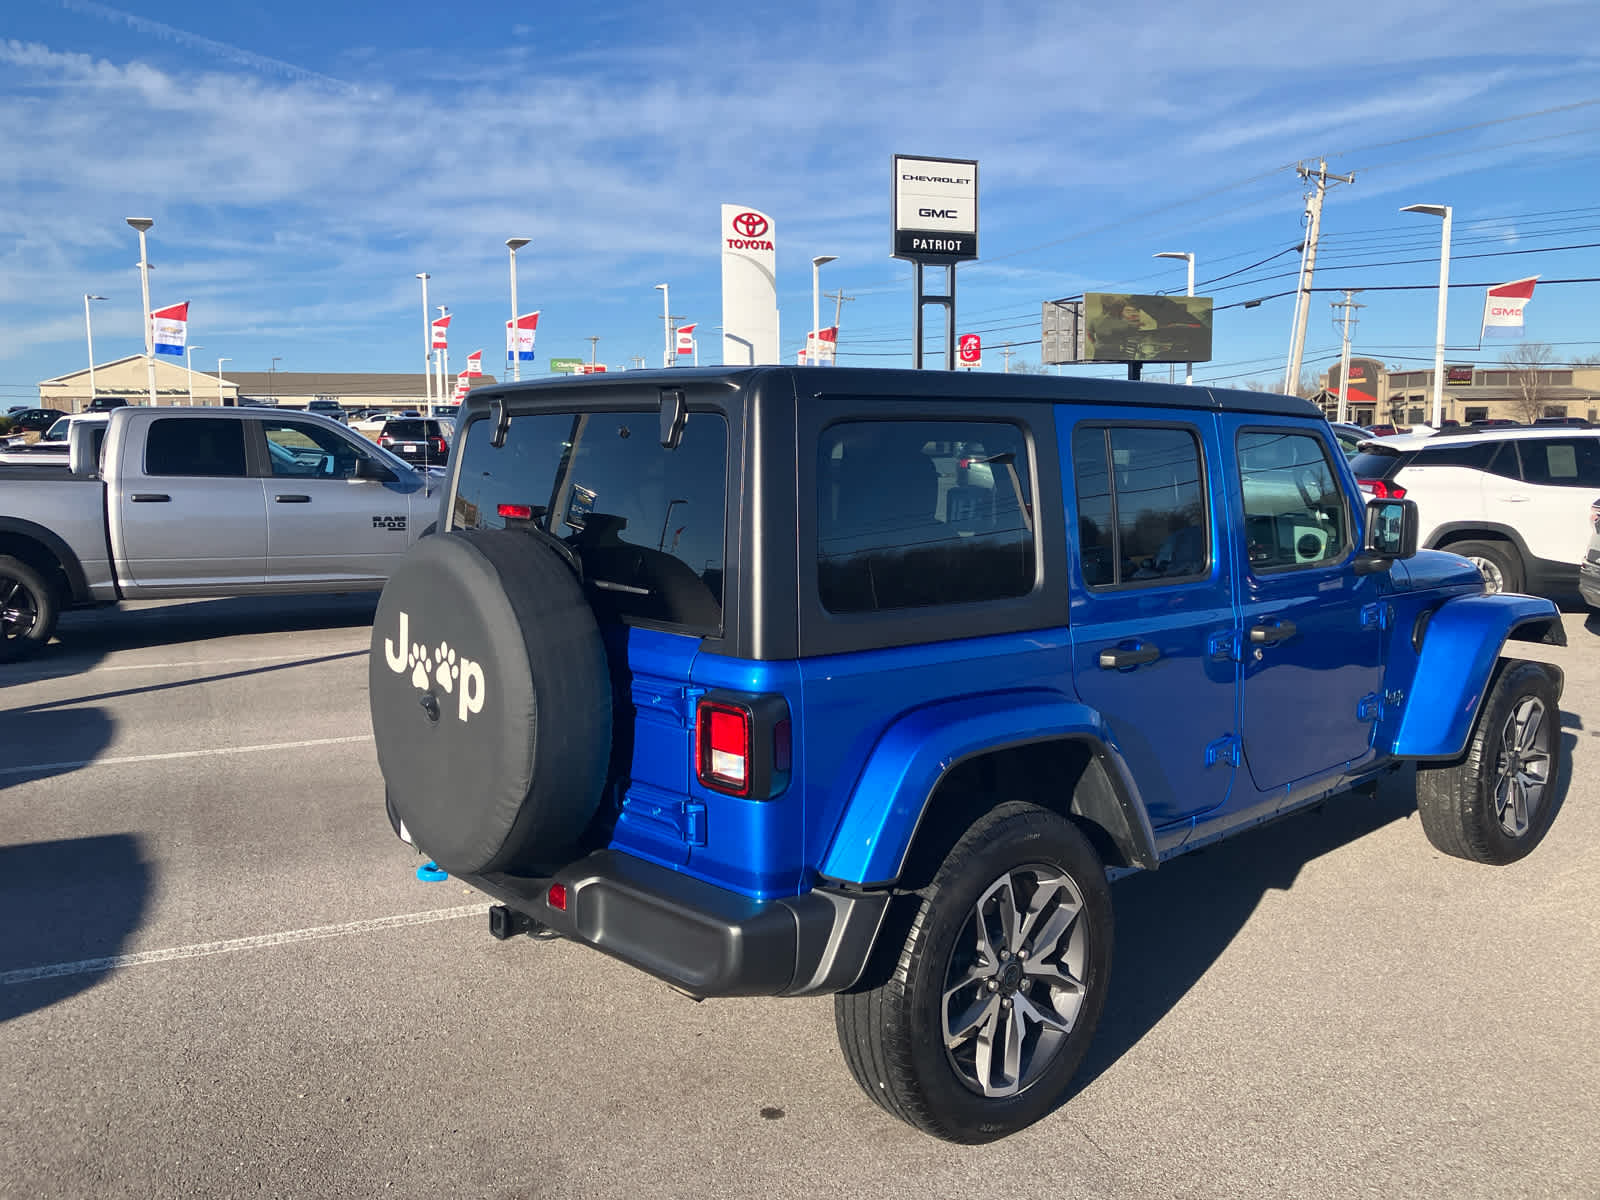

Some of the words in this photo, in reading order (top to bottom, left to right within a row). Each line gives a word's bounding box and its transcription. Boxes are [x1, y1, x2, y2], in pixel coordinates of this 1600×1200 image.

[902, 174, 971, 185] CHEVROLET
[918, 208, 958, 219] GMC
[727, 239, 774, 251] TOYOTA
[912, 238, 962, 251] PATRIOT
[1490, 307, 1523, 316] GMC
